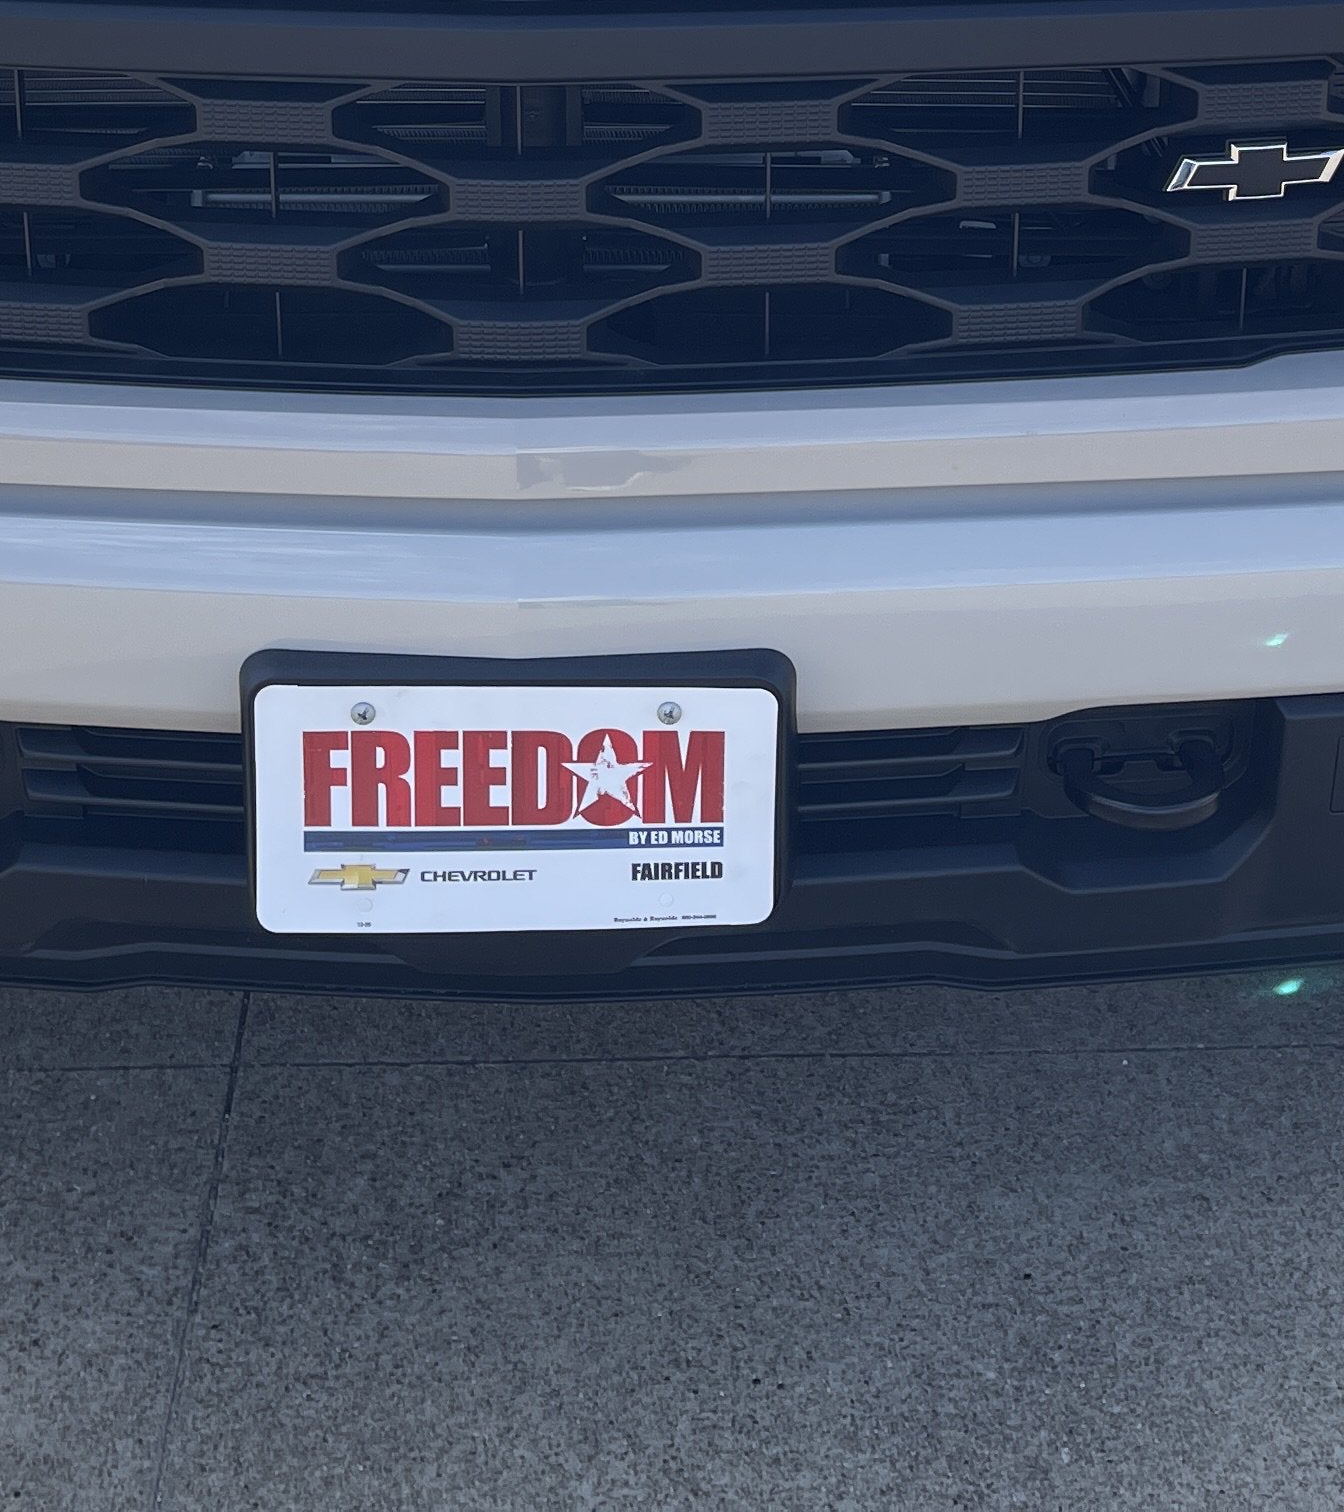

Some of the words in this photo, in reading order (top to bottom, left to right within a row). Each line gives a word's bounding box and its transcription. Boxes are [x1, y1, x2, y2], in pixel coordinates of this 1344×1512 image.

[302, 728, 725, 827] FREEDOM
[628, 831, 648, 845] BY
[650, 830, 668, 845] ED
[671, 829, 721, 844] MORSE
[420, 869, 537, 883] CHEVROLET
[631, 861, 723, 882] FAIRFIELD
